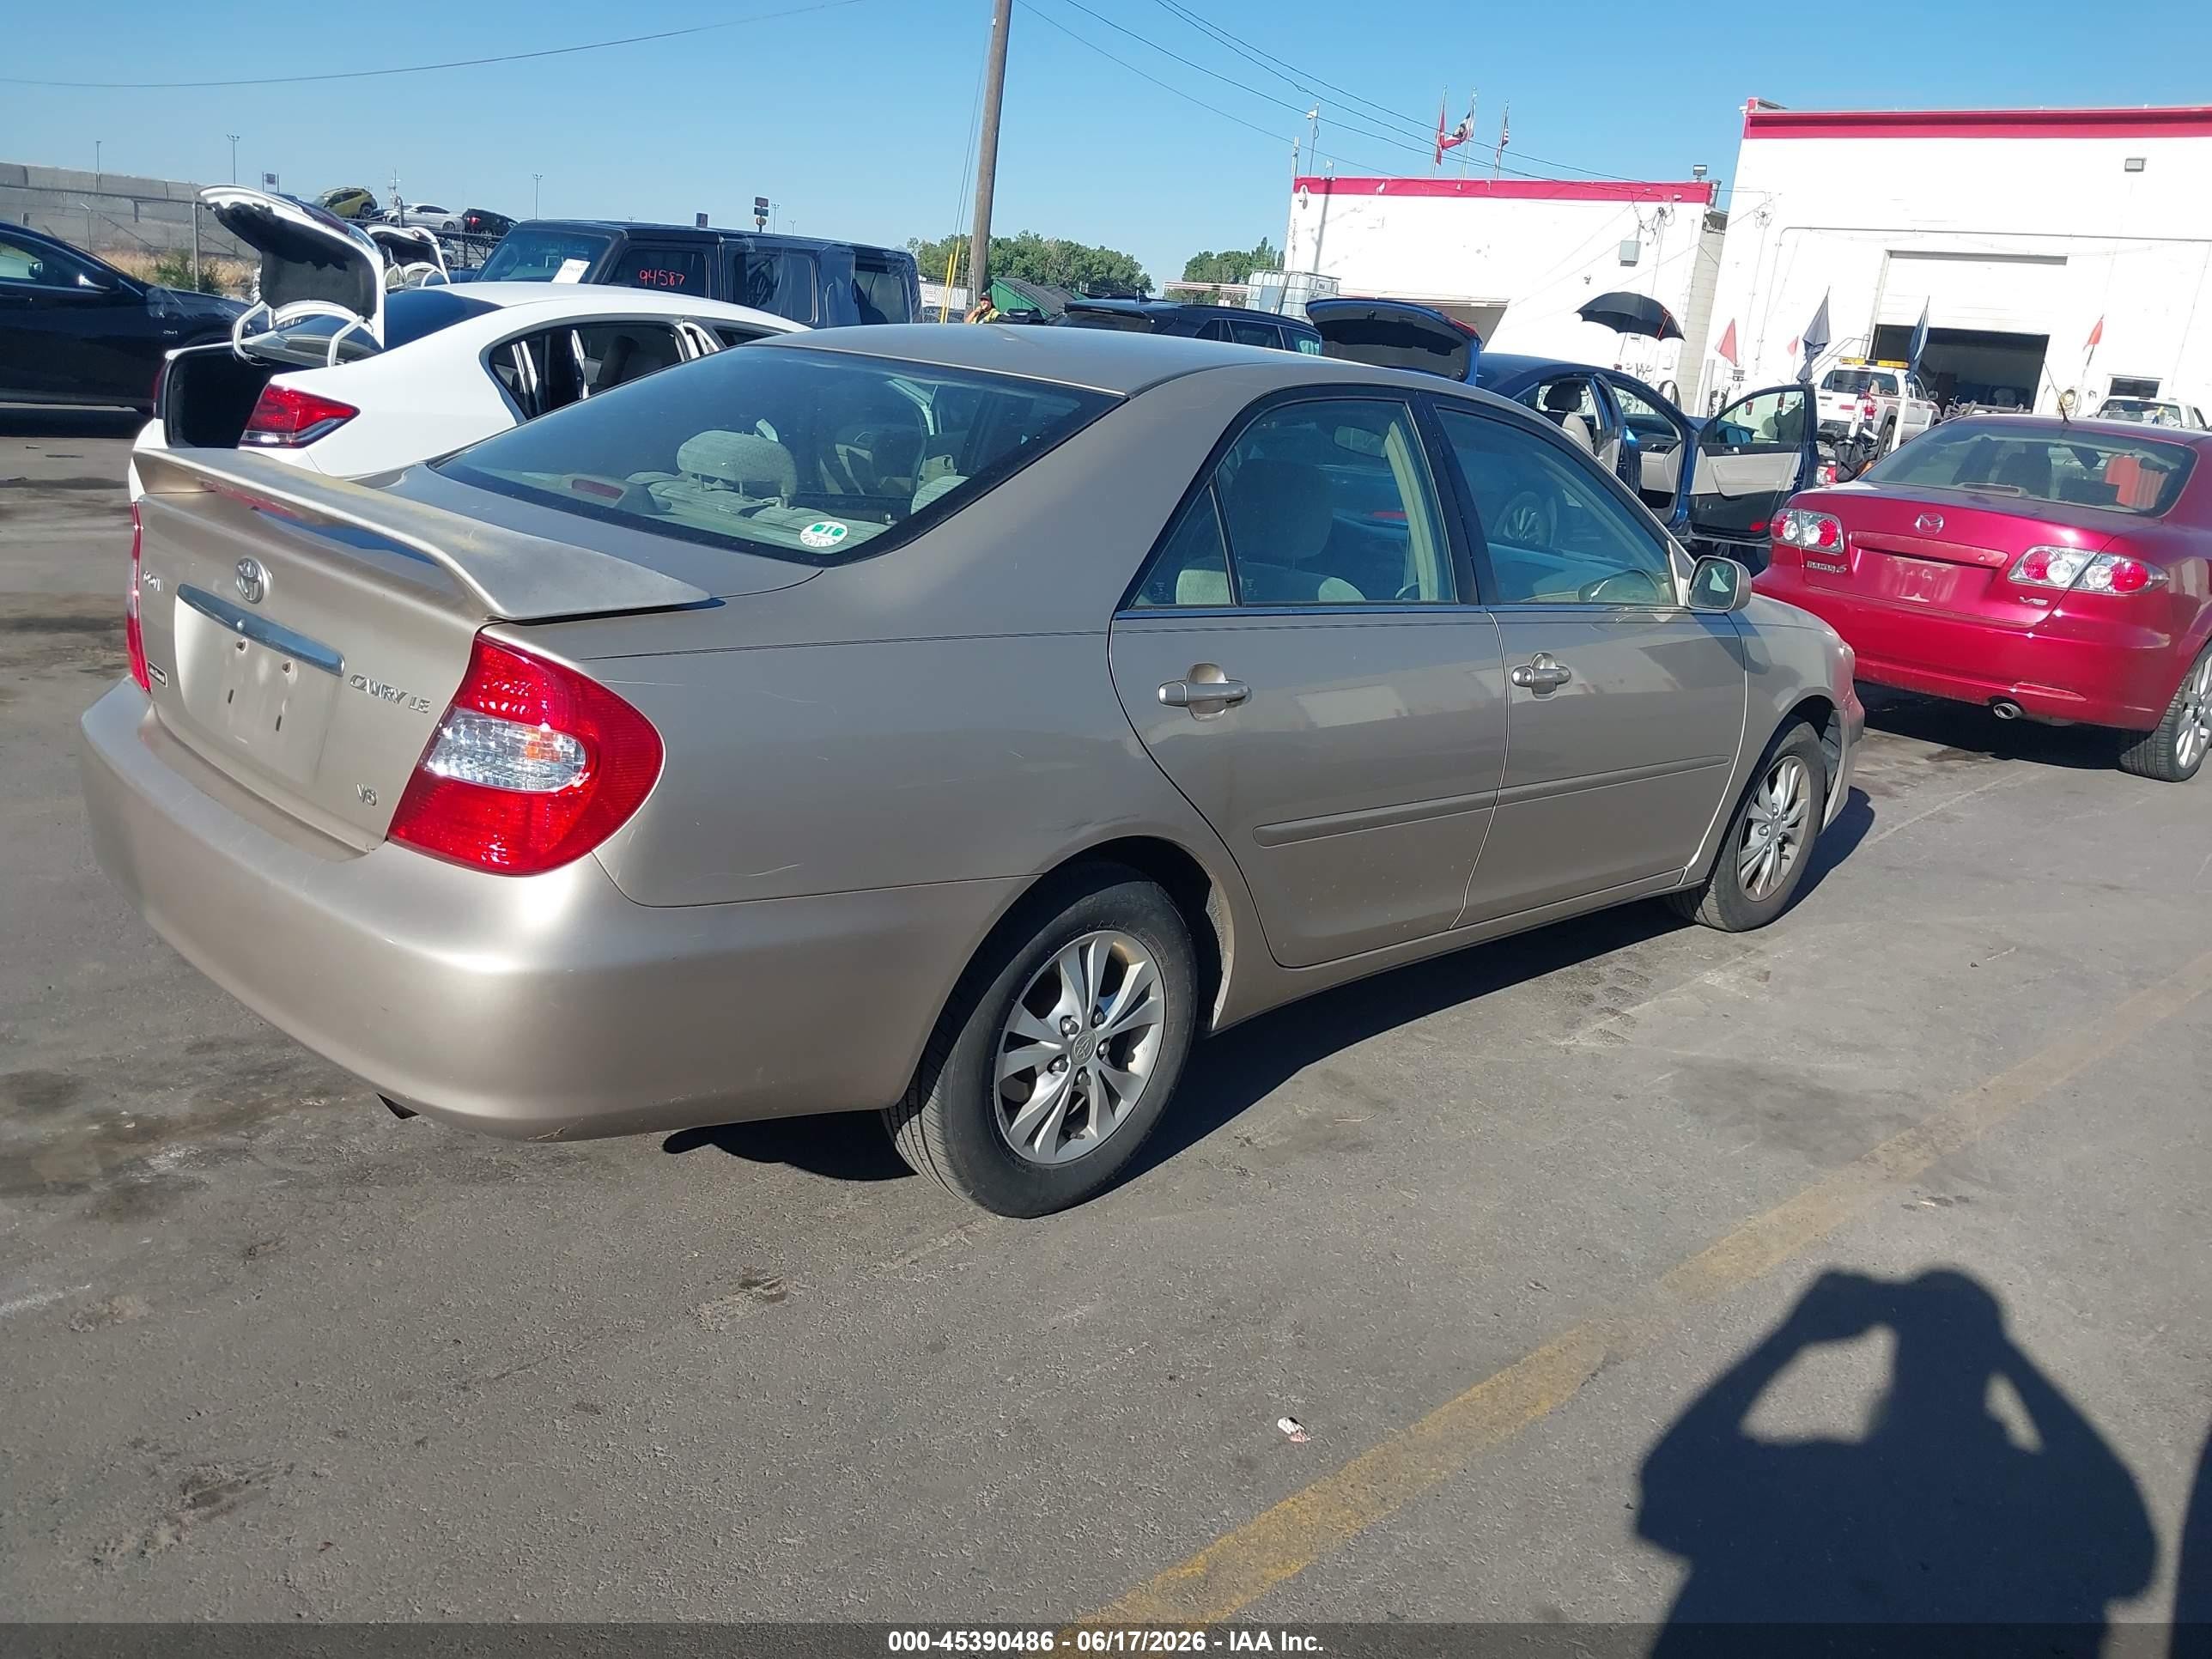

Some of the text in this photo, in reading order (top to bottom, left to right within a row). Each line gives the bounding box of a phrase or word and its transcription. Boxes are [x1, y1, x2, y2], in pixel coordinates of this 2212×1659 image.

[639, 269, 685, 286] 94587
[811, 524, 846, 537] BIG
[349, 674, 430, 714] CAMRY LE
[356, 782, 377, 806] V6
